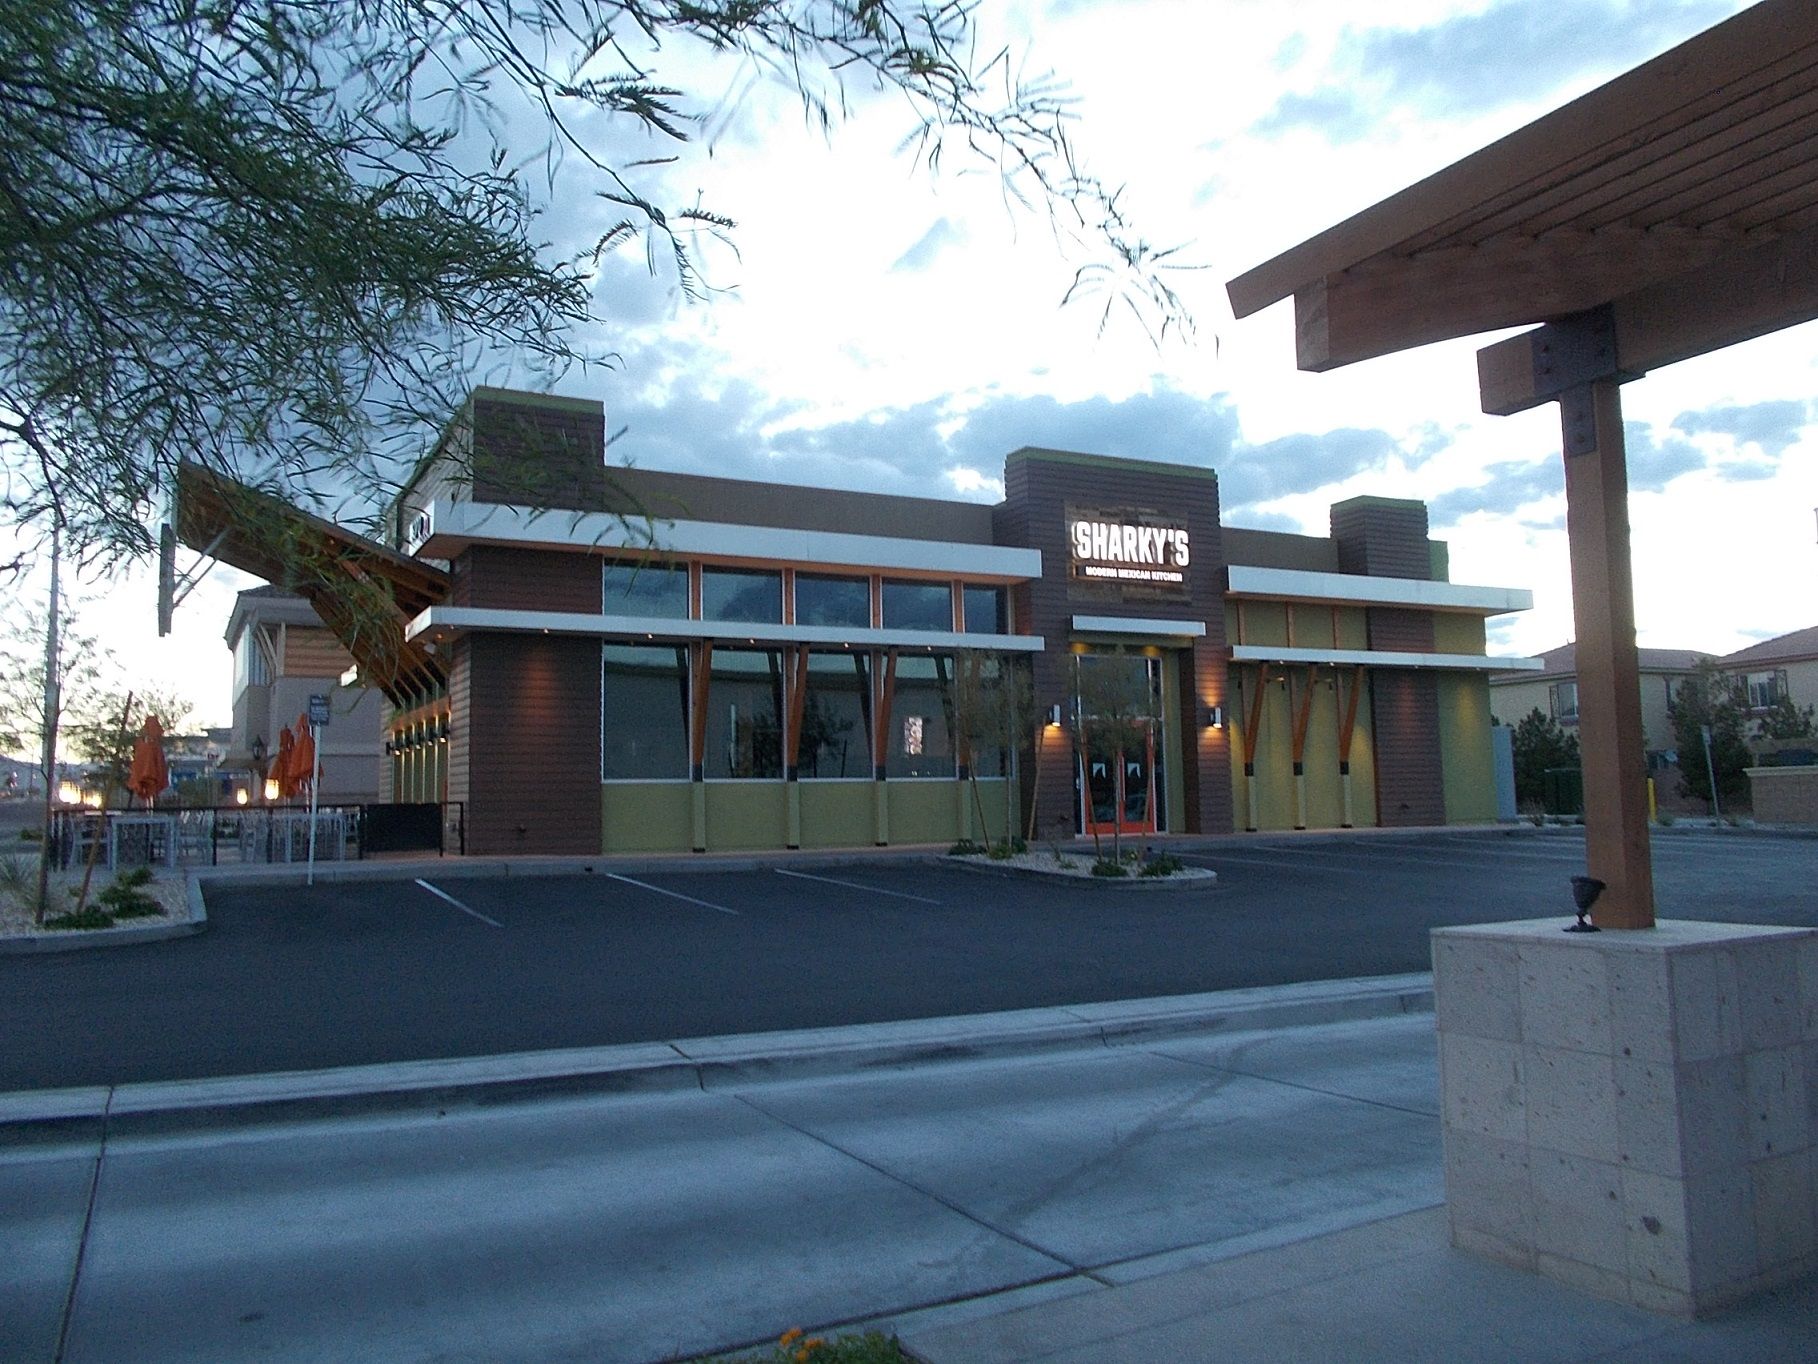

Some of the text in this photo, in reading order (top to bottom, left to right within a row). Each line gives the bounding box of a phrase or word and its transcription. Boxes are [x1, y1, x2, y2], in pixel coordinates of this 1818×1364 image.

[1073, 521, 1189, 566] SHARKY'S
[1085, 566, 1183, 582] MODERN MEXICAN KITCHEN
